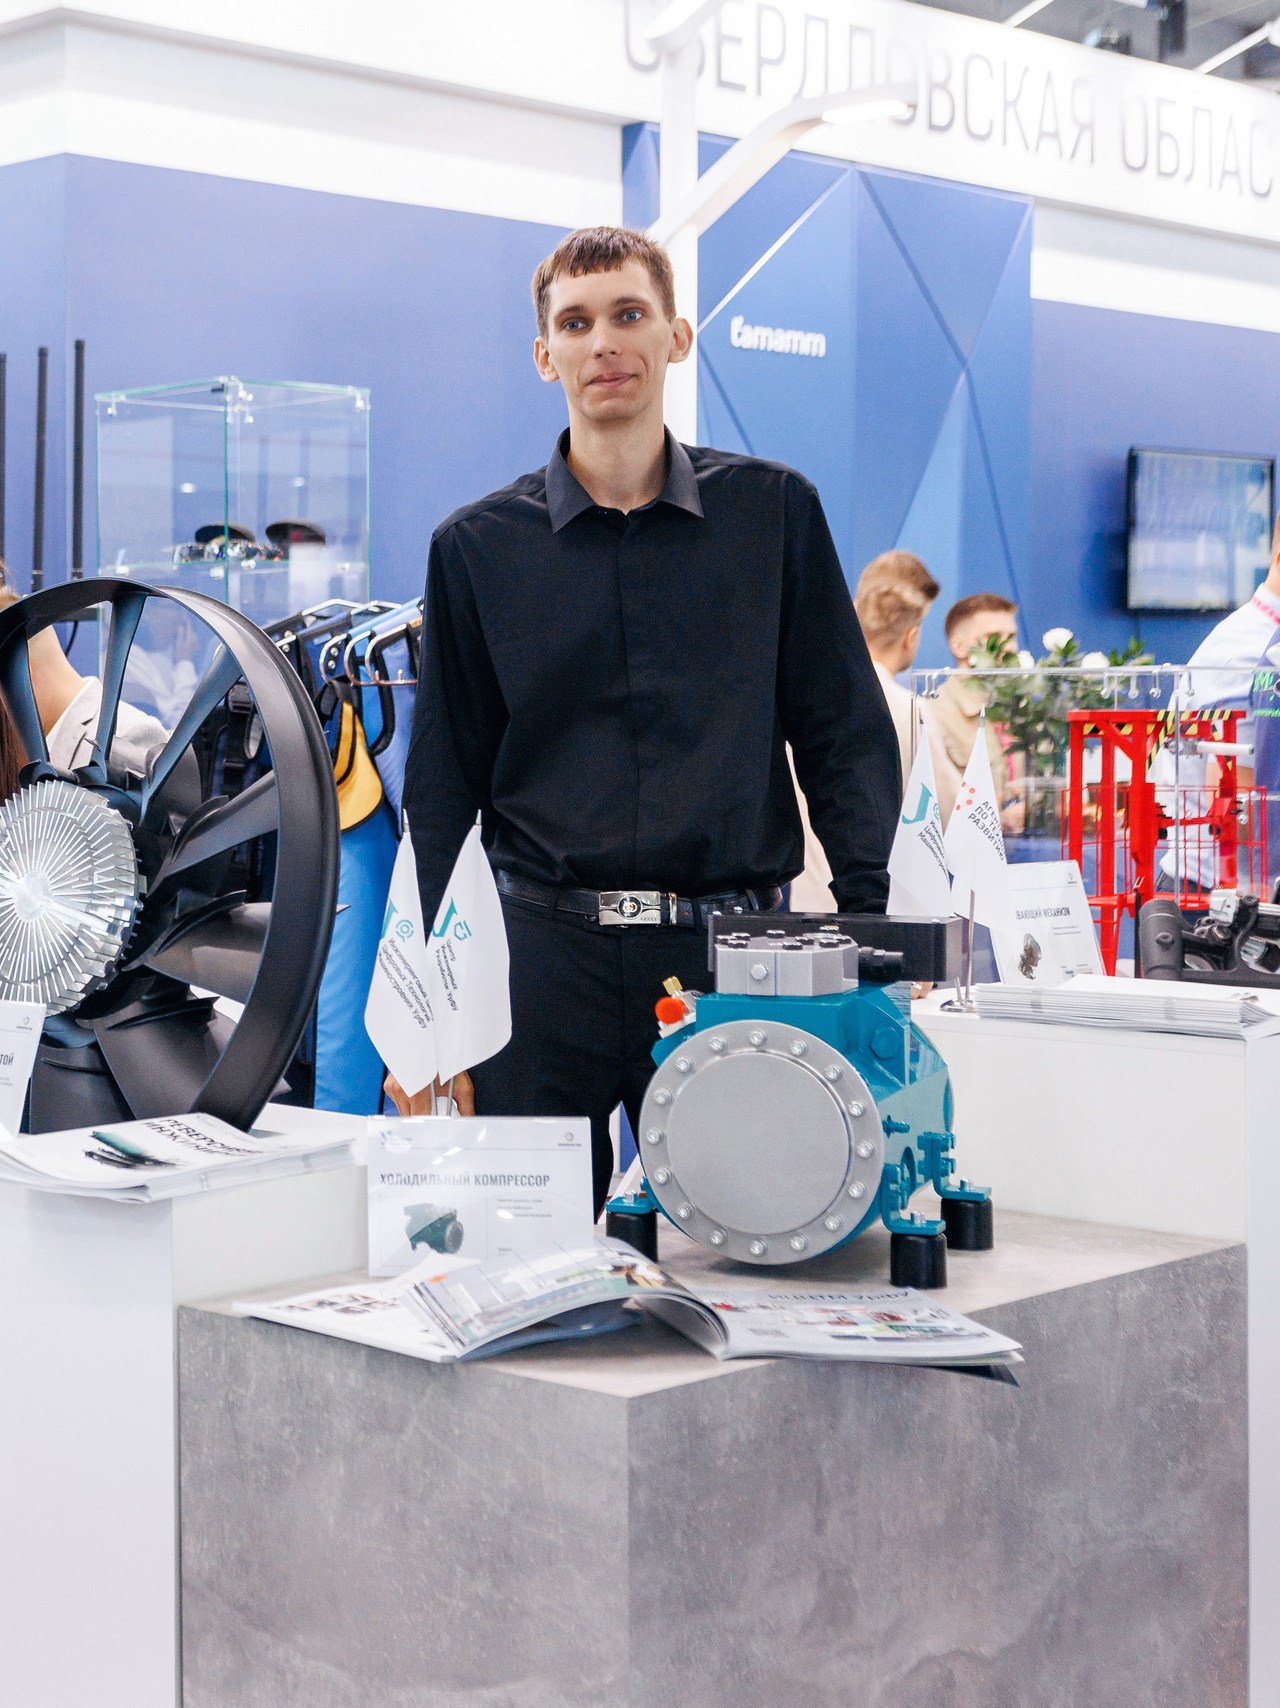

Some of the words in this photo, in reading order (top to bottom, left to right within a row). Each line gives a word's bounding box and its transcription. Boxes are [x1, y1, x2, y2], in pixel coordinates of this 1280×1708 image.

[975, 806, 989, 820] ПО
[379, 1171, 471, 1189] ХОЛОДИЛЬНЫЙ
[474, 1173, 551, 1188] КОМПРЕССОР
